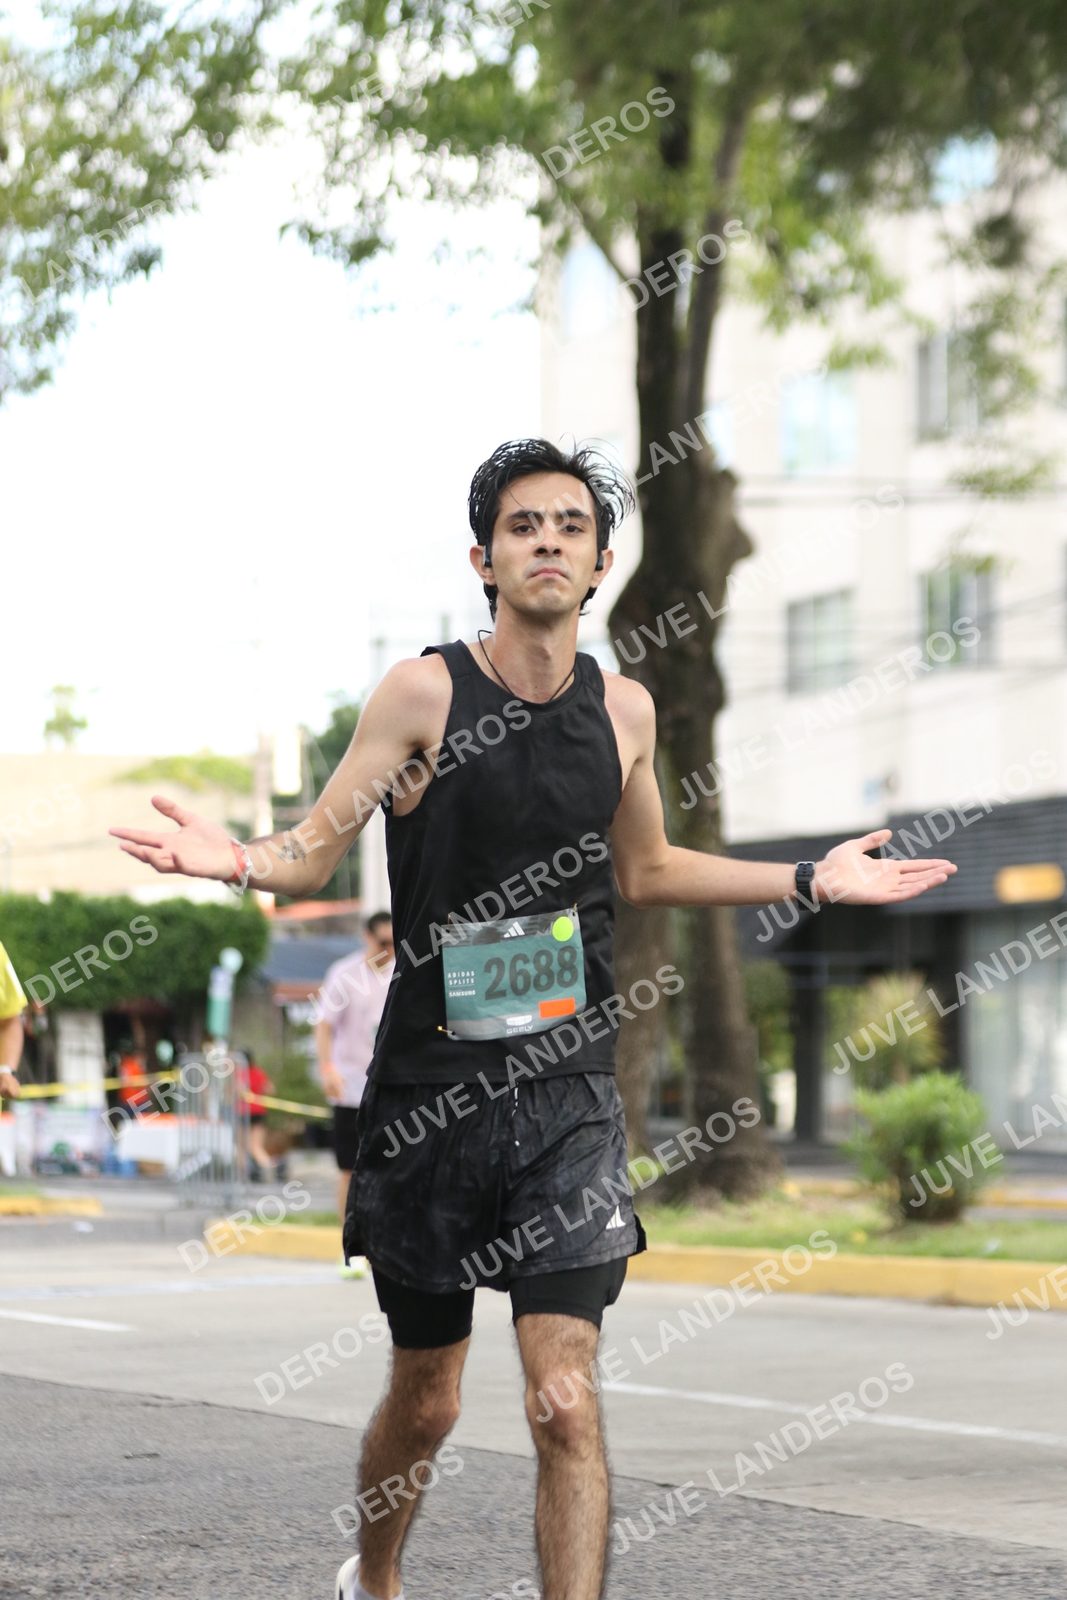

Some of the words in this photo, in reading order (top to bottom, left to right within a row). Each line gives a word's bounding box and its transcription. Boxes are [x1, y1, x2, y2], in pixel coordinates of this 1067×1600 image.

[447, 970, 475, 978] ADIDAS
[484, 945, 579, 1000] 2688
[506, 1025, 533, 1034] GEELY
